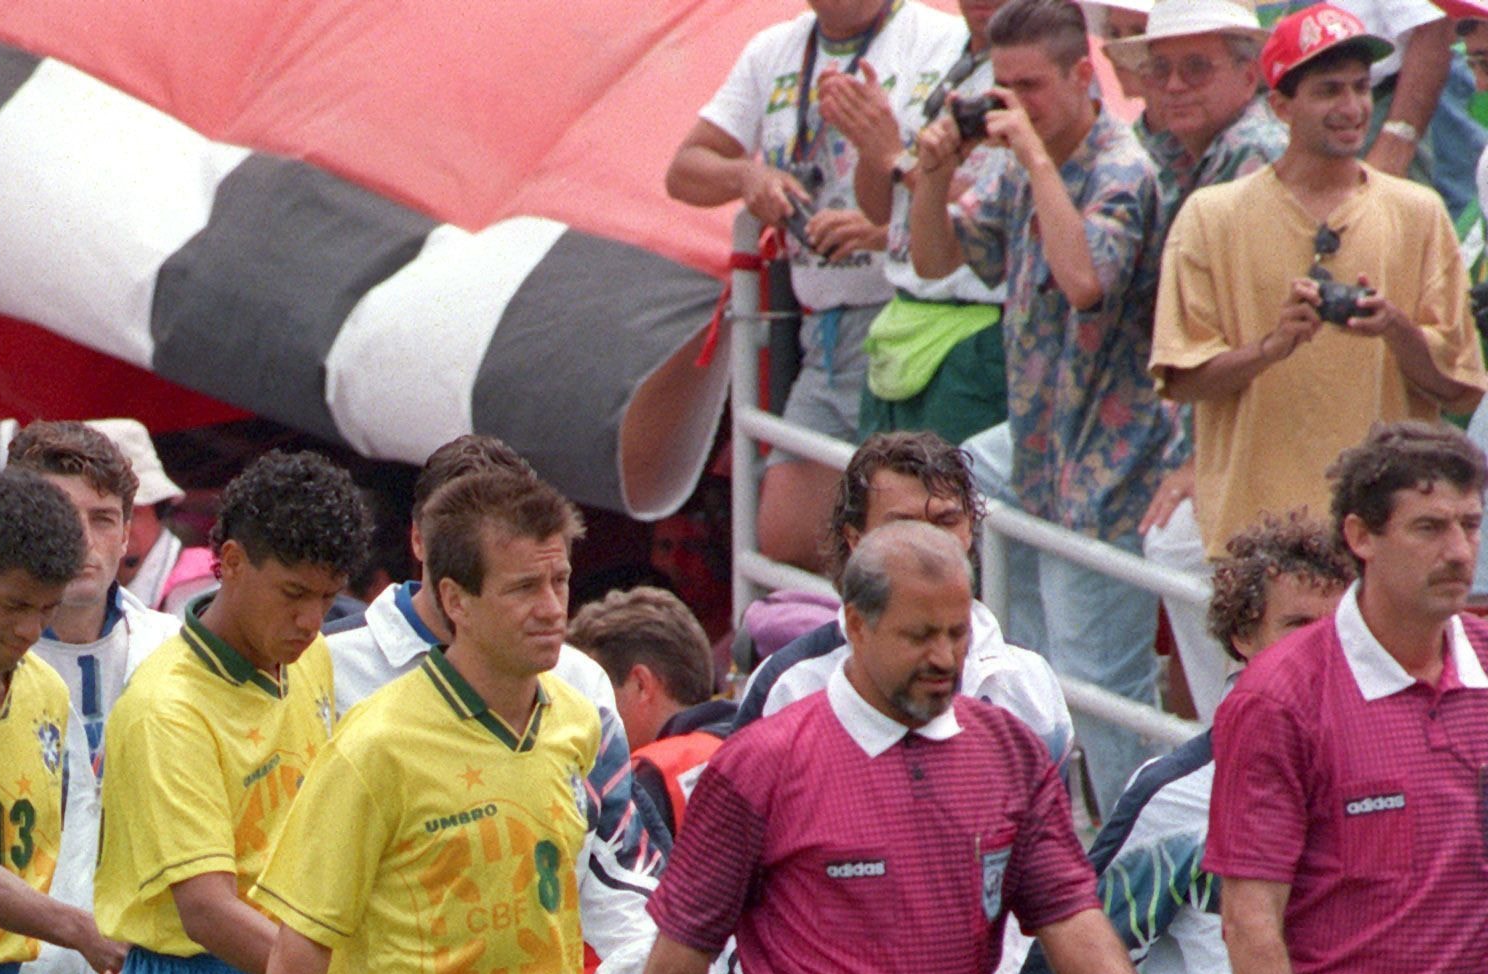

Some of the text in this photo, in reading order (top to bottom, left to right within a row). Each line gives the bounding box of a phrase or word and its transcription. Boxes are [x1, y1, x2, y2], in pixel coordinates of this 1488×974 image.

[425, 804, 497, 833] UMBRO
[1346, 794, 1405, 815] adidas
[535, 840, 560, 913] 8
[826, 860, 886, 878] adidas
[466, 899, 528, 934] CBF
